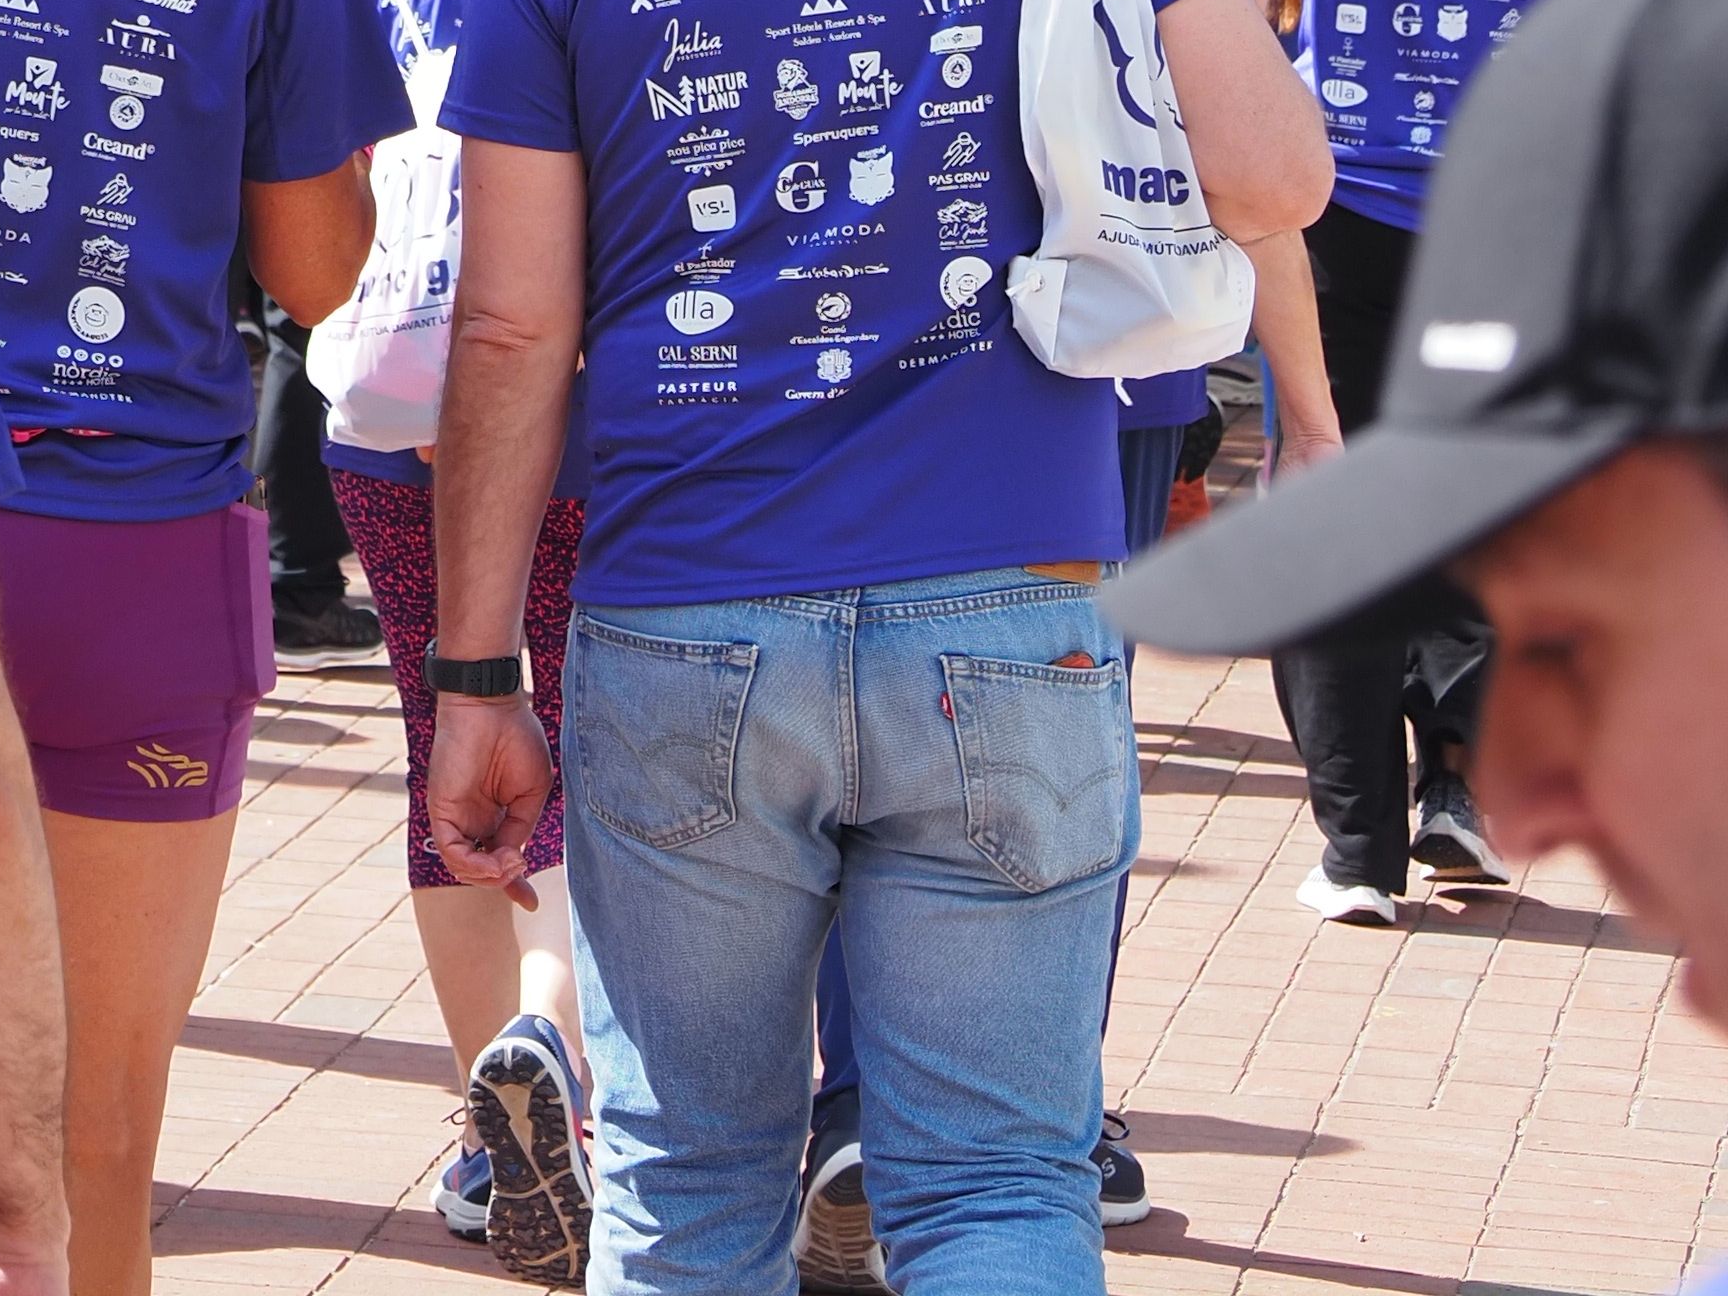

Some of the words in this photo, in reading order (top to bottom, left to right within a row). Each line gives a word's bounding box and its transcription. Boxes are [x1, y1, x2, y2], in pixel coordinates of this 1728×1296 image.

[13, 15, 42, 32] Resort
[53, 23, 70, 37] Spa
[765, 26, 790, 41] Sport
[792, 22, 823, 35] Hotels
[828, 18, 855, 30] Resort
[867, 13, 886, 26] Spa
[97, 27, 177, 61] AURA
[663, 17, 723, 73] Júlia
[1397, 47, 1459, 60] VIAMODA
[695, 71, 749, 93] NATUR
[1326, 80, 1355, 100] illa
[696, 89, 741, 114] LAND
[793, 124, 880, 147] Sperruquers
[666, 144, 690, 158] nou
[692, 143, 719, 160] pica
[721, 137, 746, 155] pica
[929, 174, 952, 187] PAS
[954, 171, 990, 184] GRAU
[1101, 159, 1190, 206] mac
[80, 206, 106, 220] PAS
[106, 211, 137, 226] GRAU
[696, 200, 730, 215] VSL
[787, 222, 886, 247] VIAMODA
[674, 290, 715, 320] illa
[948, 328, 981, 340] HOTEL
[658, 346, 687, 362] CAL
[690, 345, 738, 361] SERNI
[657, 381, 738, 394] PASTEUR
[784, 388, 825, 400] Govern
